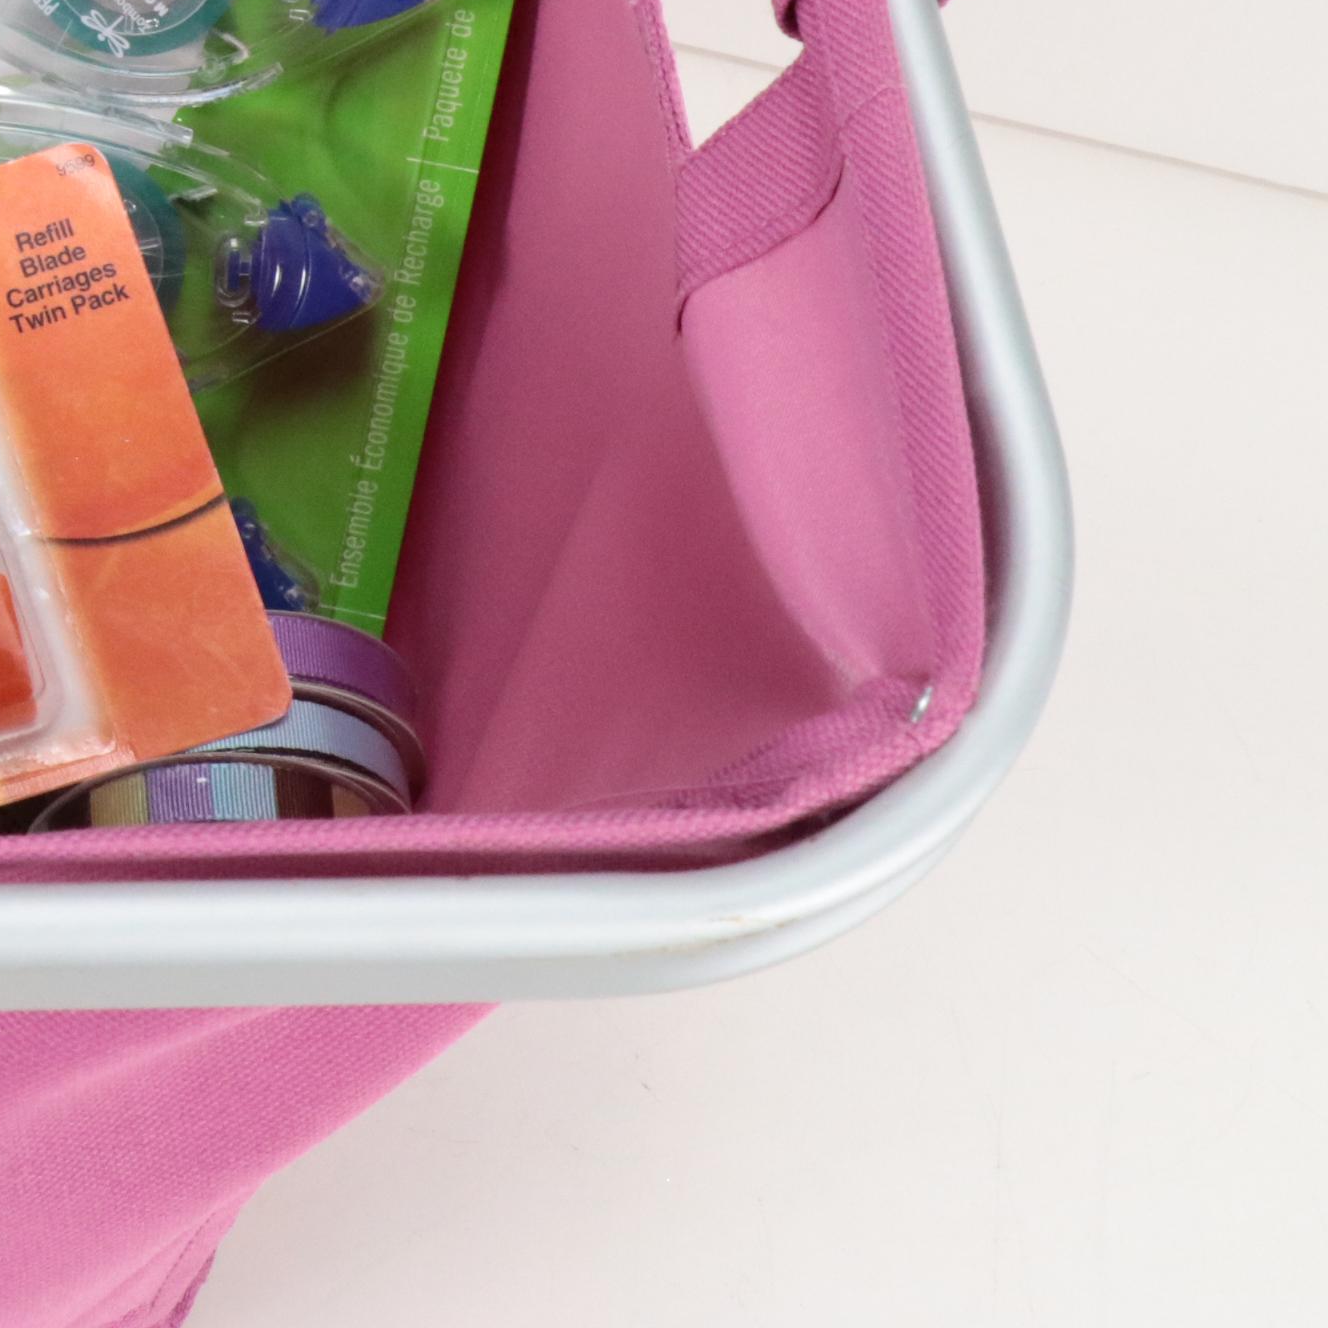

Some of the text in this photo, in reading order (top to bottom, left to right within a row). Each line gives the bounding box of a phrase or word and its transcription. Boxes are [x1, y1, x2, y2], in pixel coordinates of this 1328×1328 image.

[444, 8, 477, 40] de
[422, 45, 468, 143] Paquete
[14, 217, 76, 253] Refill
[393, 177, 445, 286] Recharge
[4, 260, 118, 311] Carriages
[18, 243, 88, 279] Blade
[8, 284, 132, 335] Twin Pack
[389, 292, 418, 324] de
[348, 330, 411, 472] Économique
[328, 479, 379, 589] Ensemble
